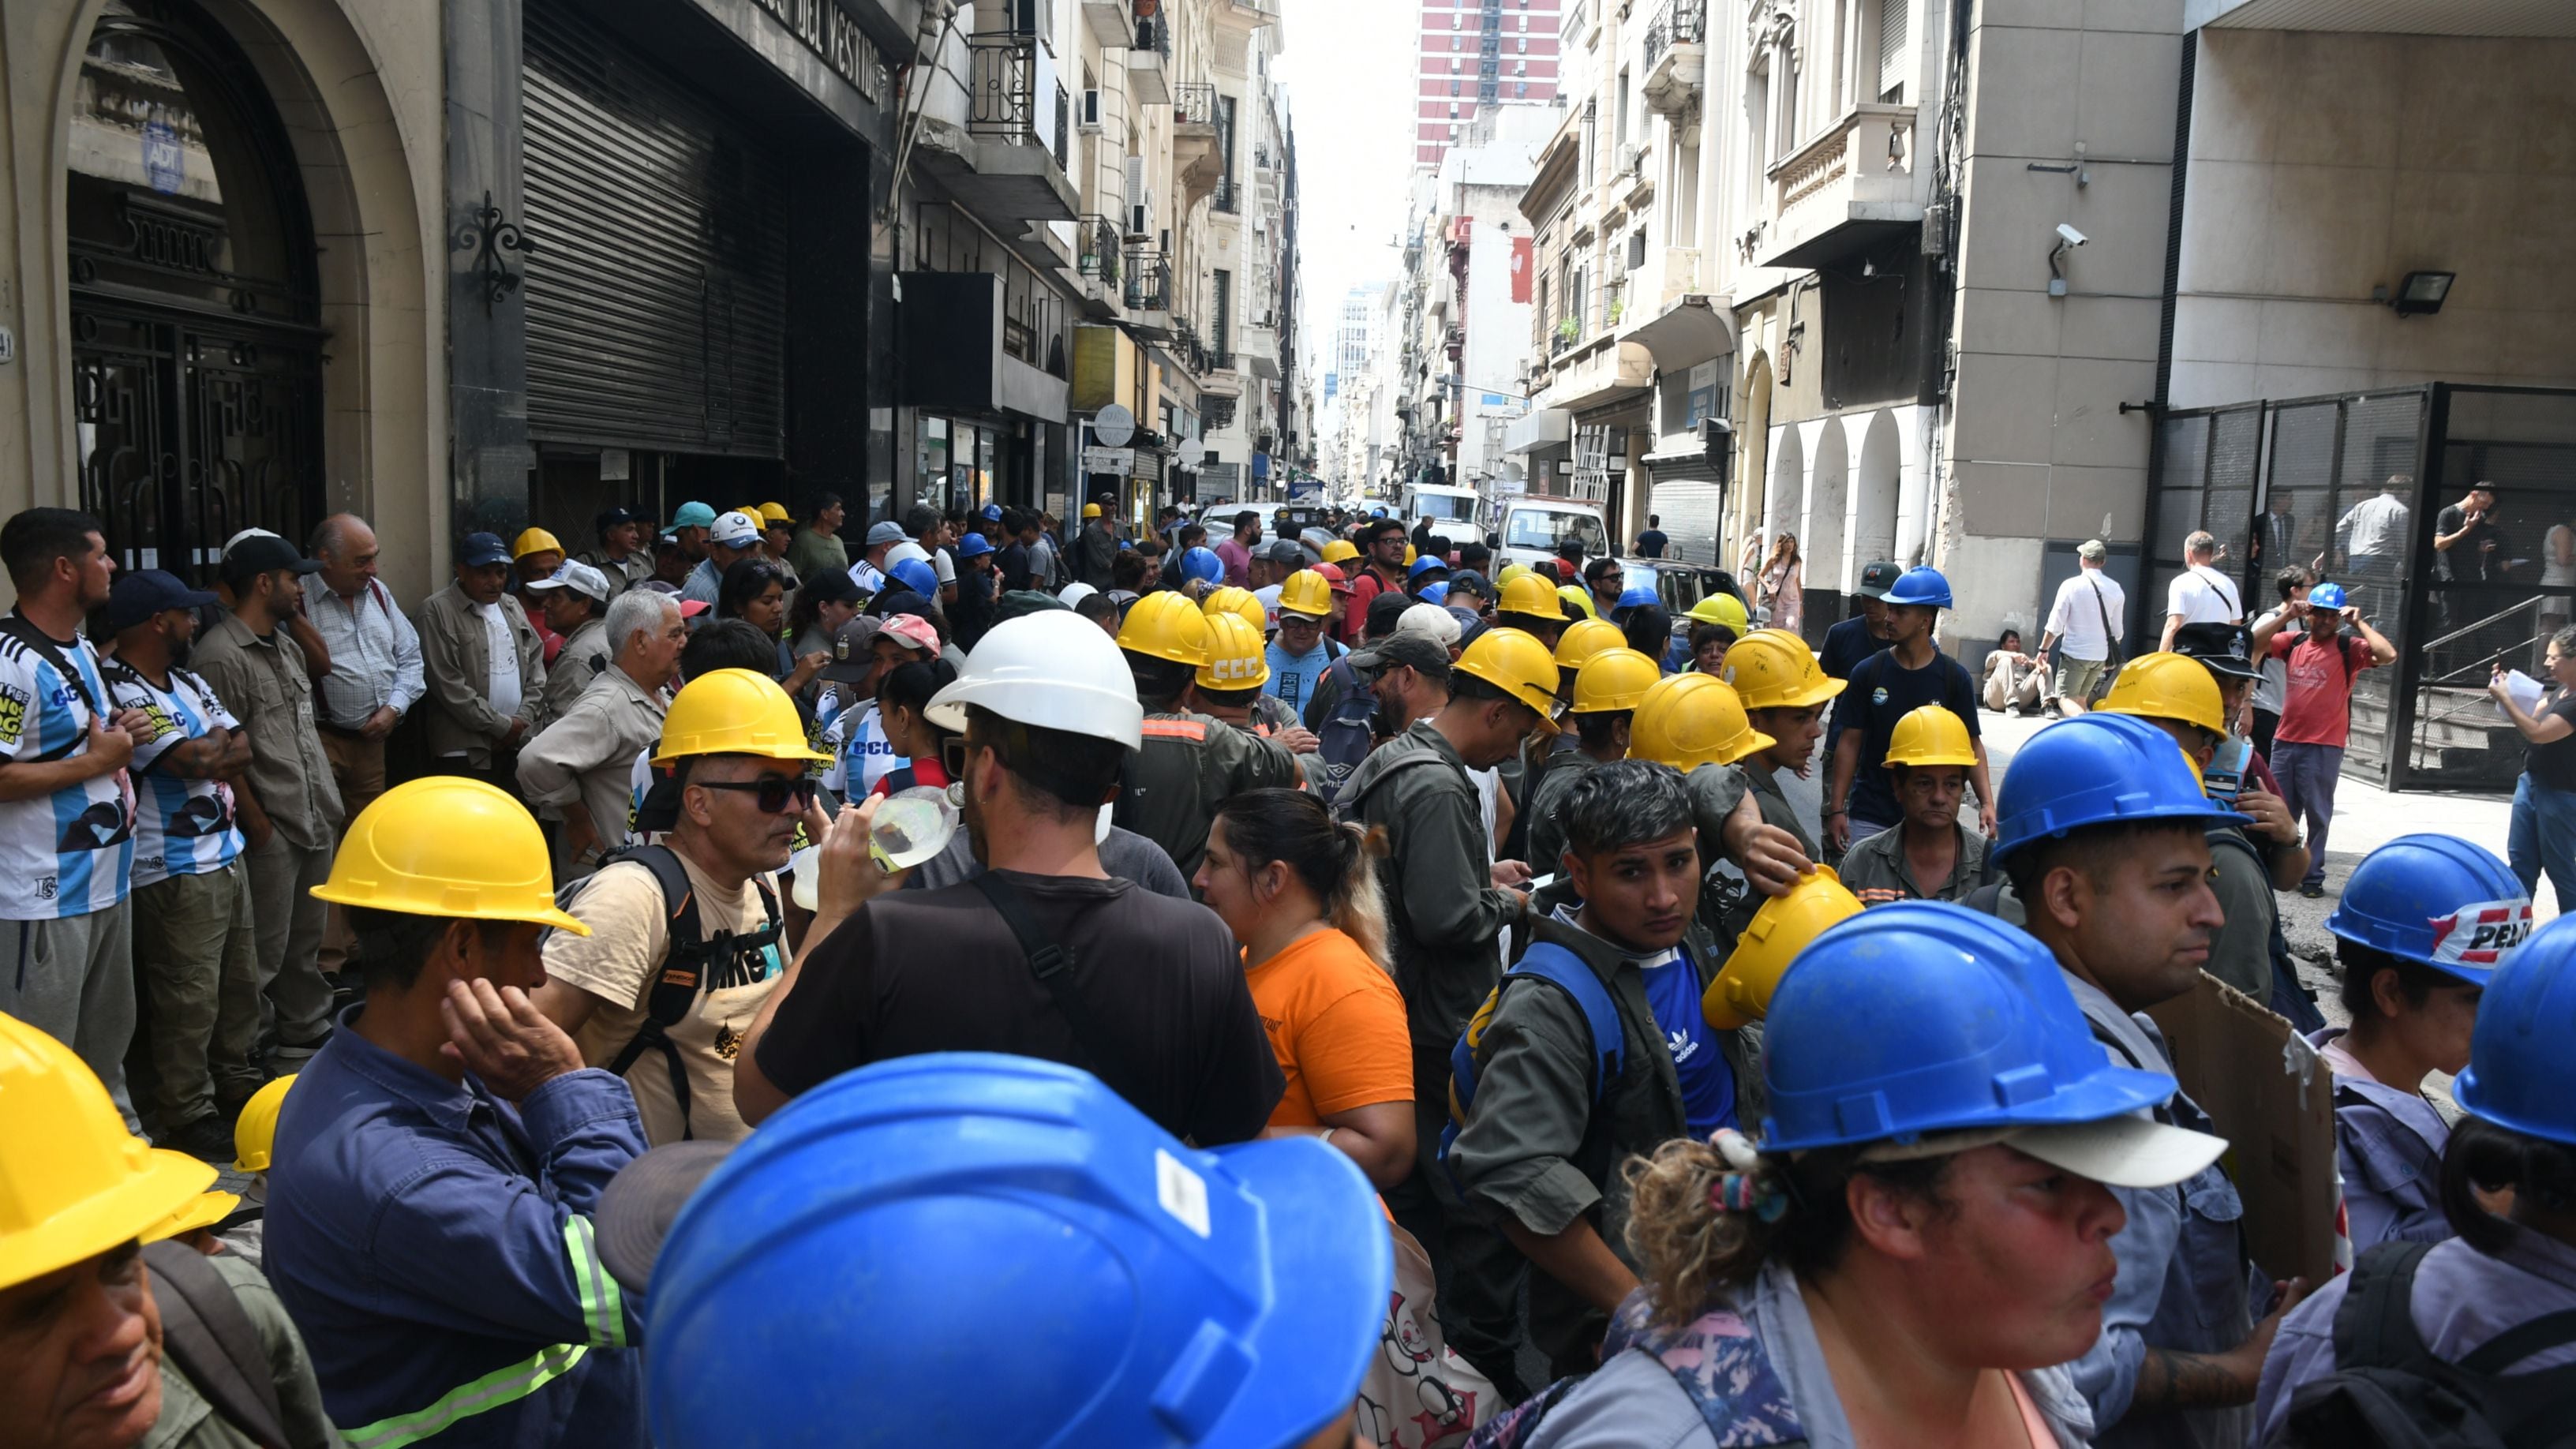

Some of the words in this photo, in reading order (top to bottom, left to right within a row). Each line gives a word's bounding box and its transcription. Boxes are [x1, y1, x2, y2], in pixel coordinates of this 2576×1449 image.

[149, 143, 178, 169] ADT
[1214, 657, 1257, 679] CCC
[1675, 1041, 1698, 1063] adidas
